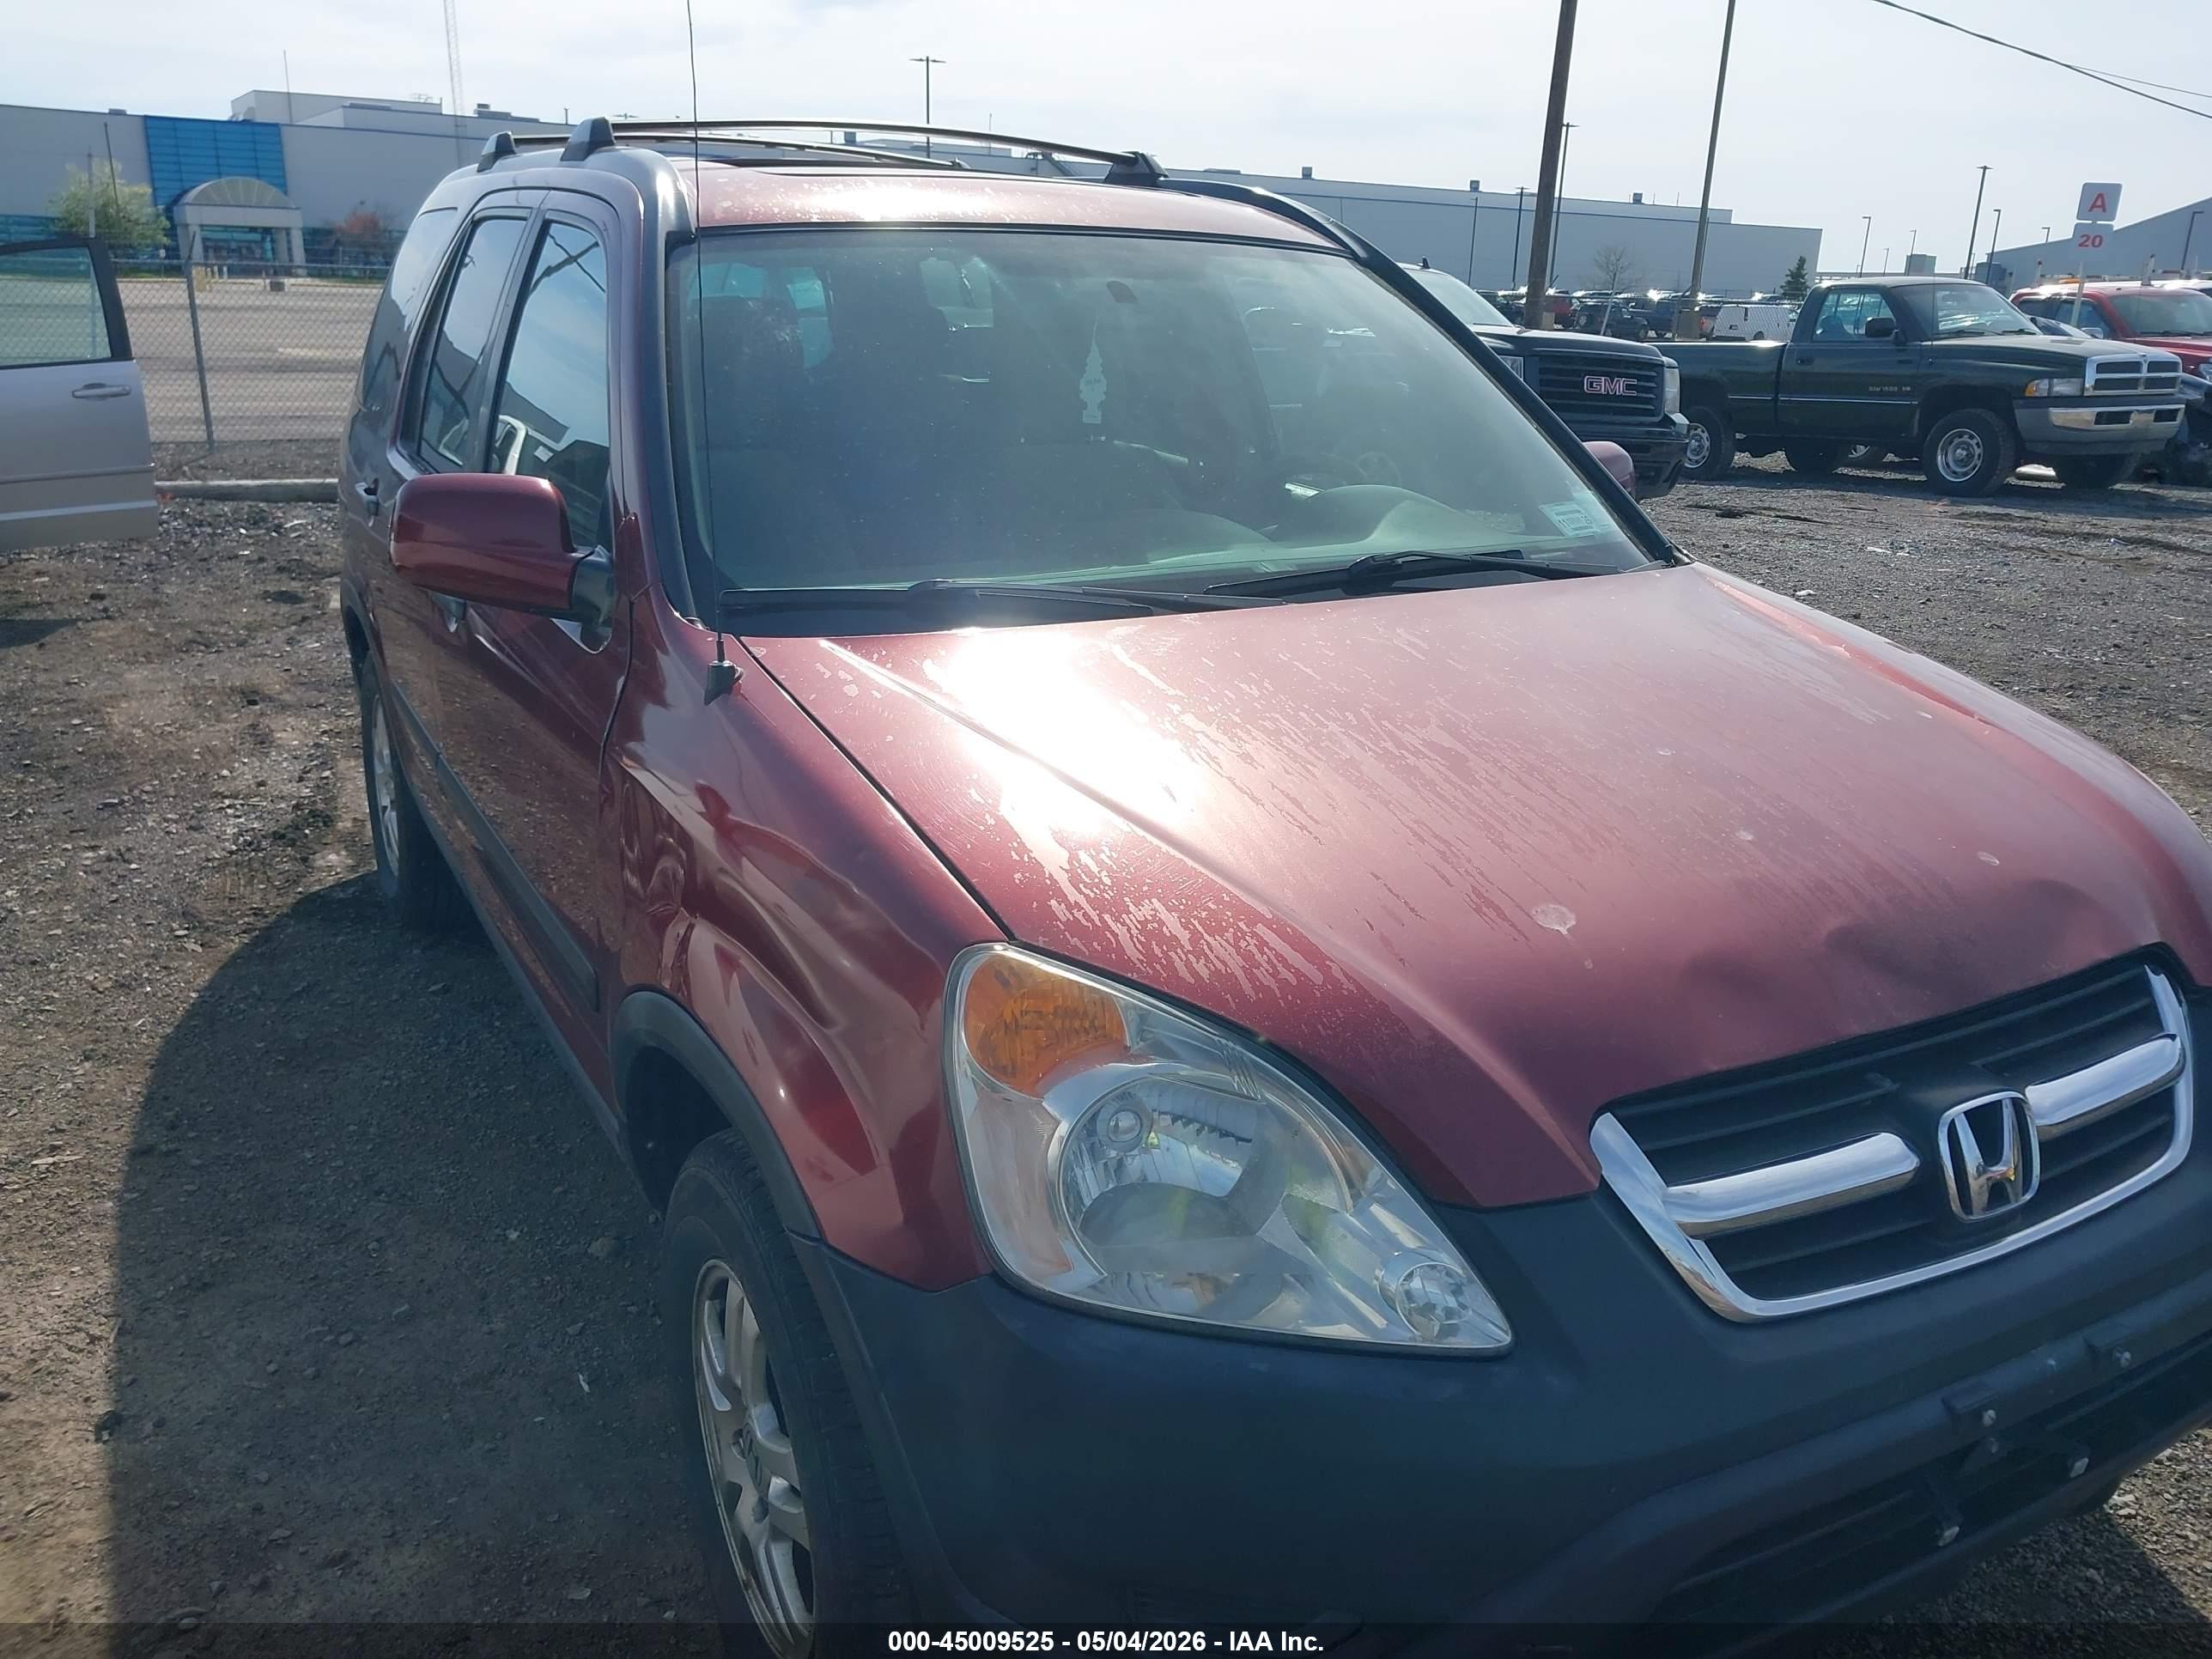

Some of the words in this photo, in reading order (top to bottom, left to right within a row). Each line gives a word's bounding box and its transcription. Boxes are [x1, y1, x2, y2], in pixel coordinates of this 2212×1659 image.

[2087, 192, 2107, 213] A
[2077, 234, 2104, 248] 20
[1583, 375, 1638, 397] GMC
